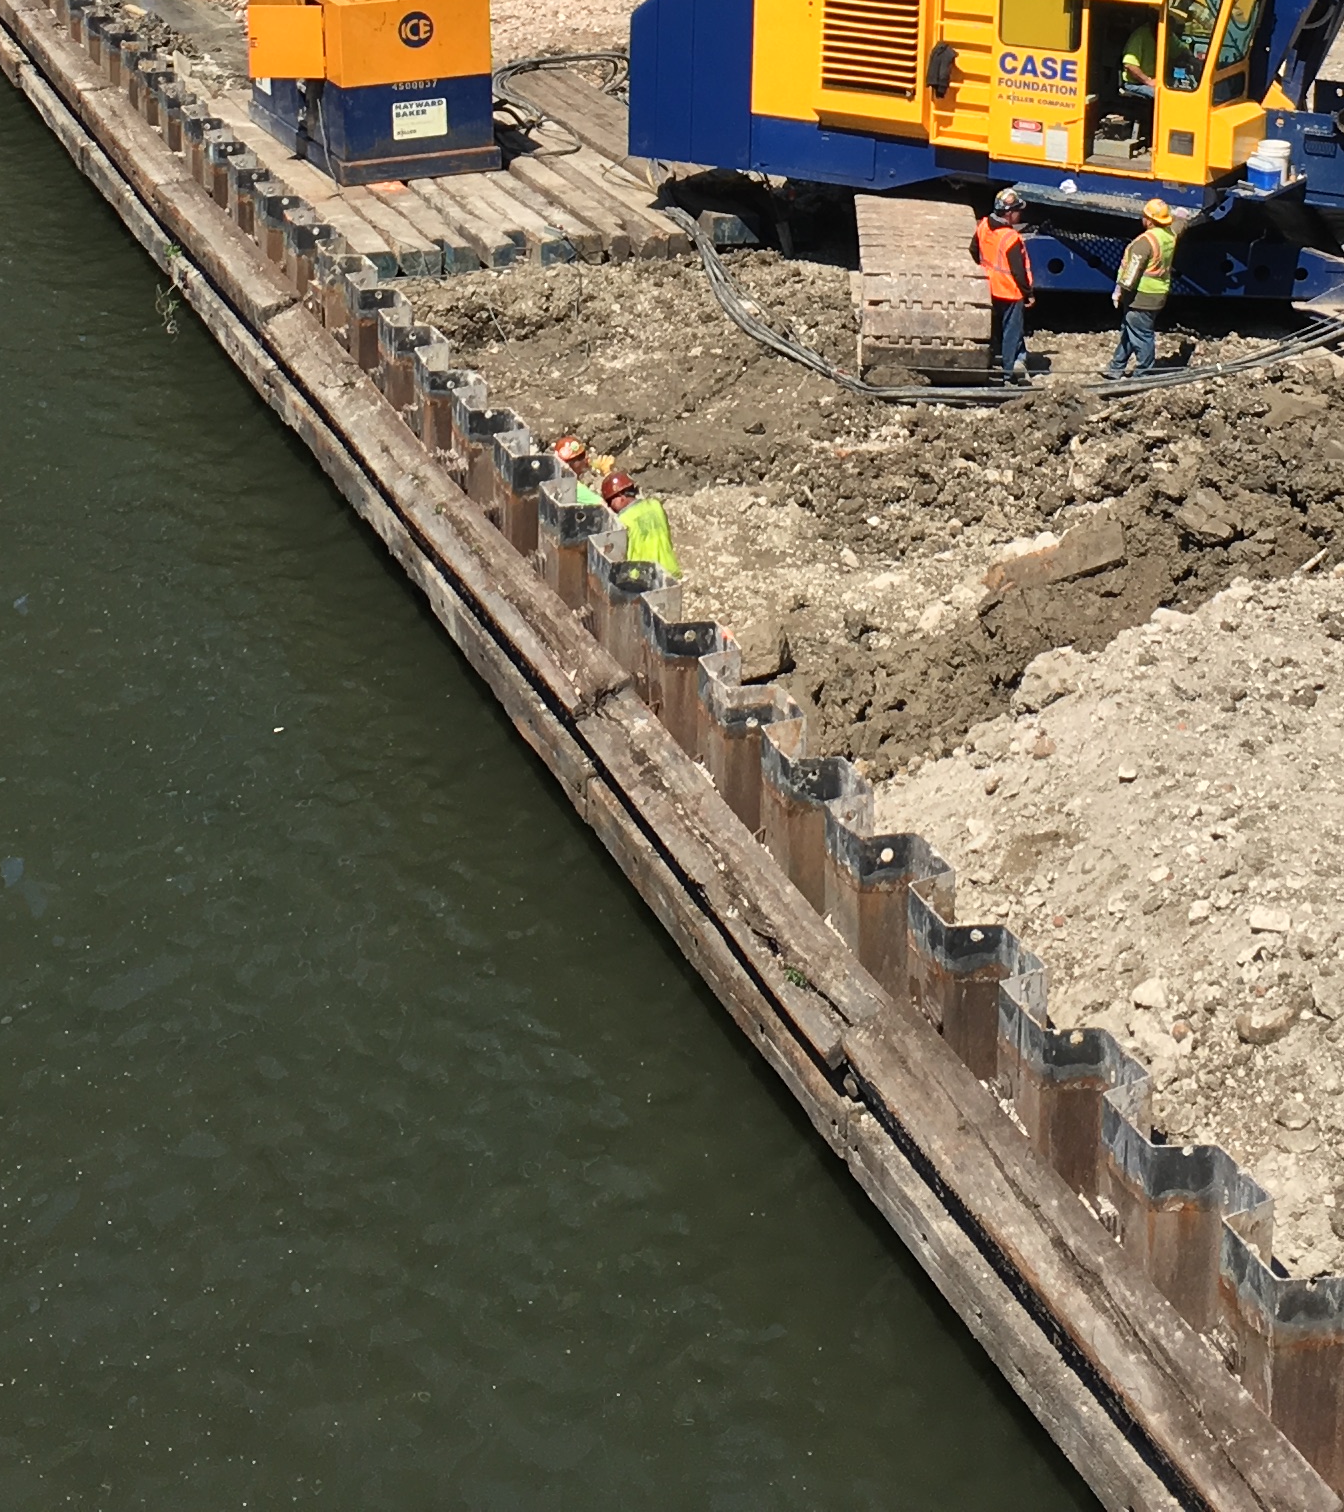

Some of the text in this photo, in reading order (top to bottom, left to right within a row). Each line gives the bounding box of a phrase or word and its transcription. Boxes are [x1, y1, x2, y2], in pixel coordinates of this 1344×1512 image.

[401, 18, 431, 41] ICE
[999, 51, 1078, 83] CASE
[998, 77, 1077, 97] FOUNDATION
[394, 99, 444, 111] HAYWARD
[1037, 98, 1076, 109] COMPANY
[395, 108, 427, 118] BAKER
